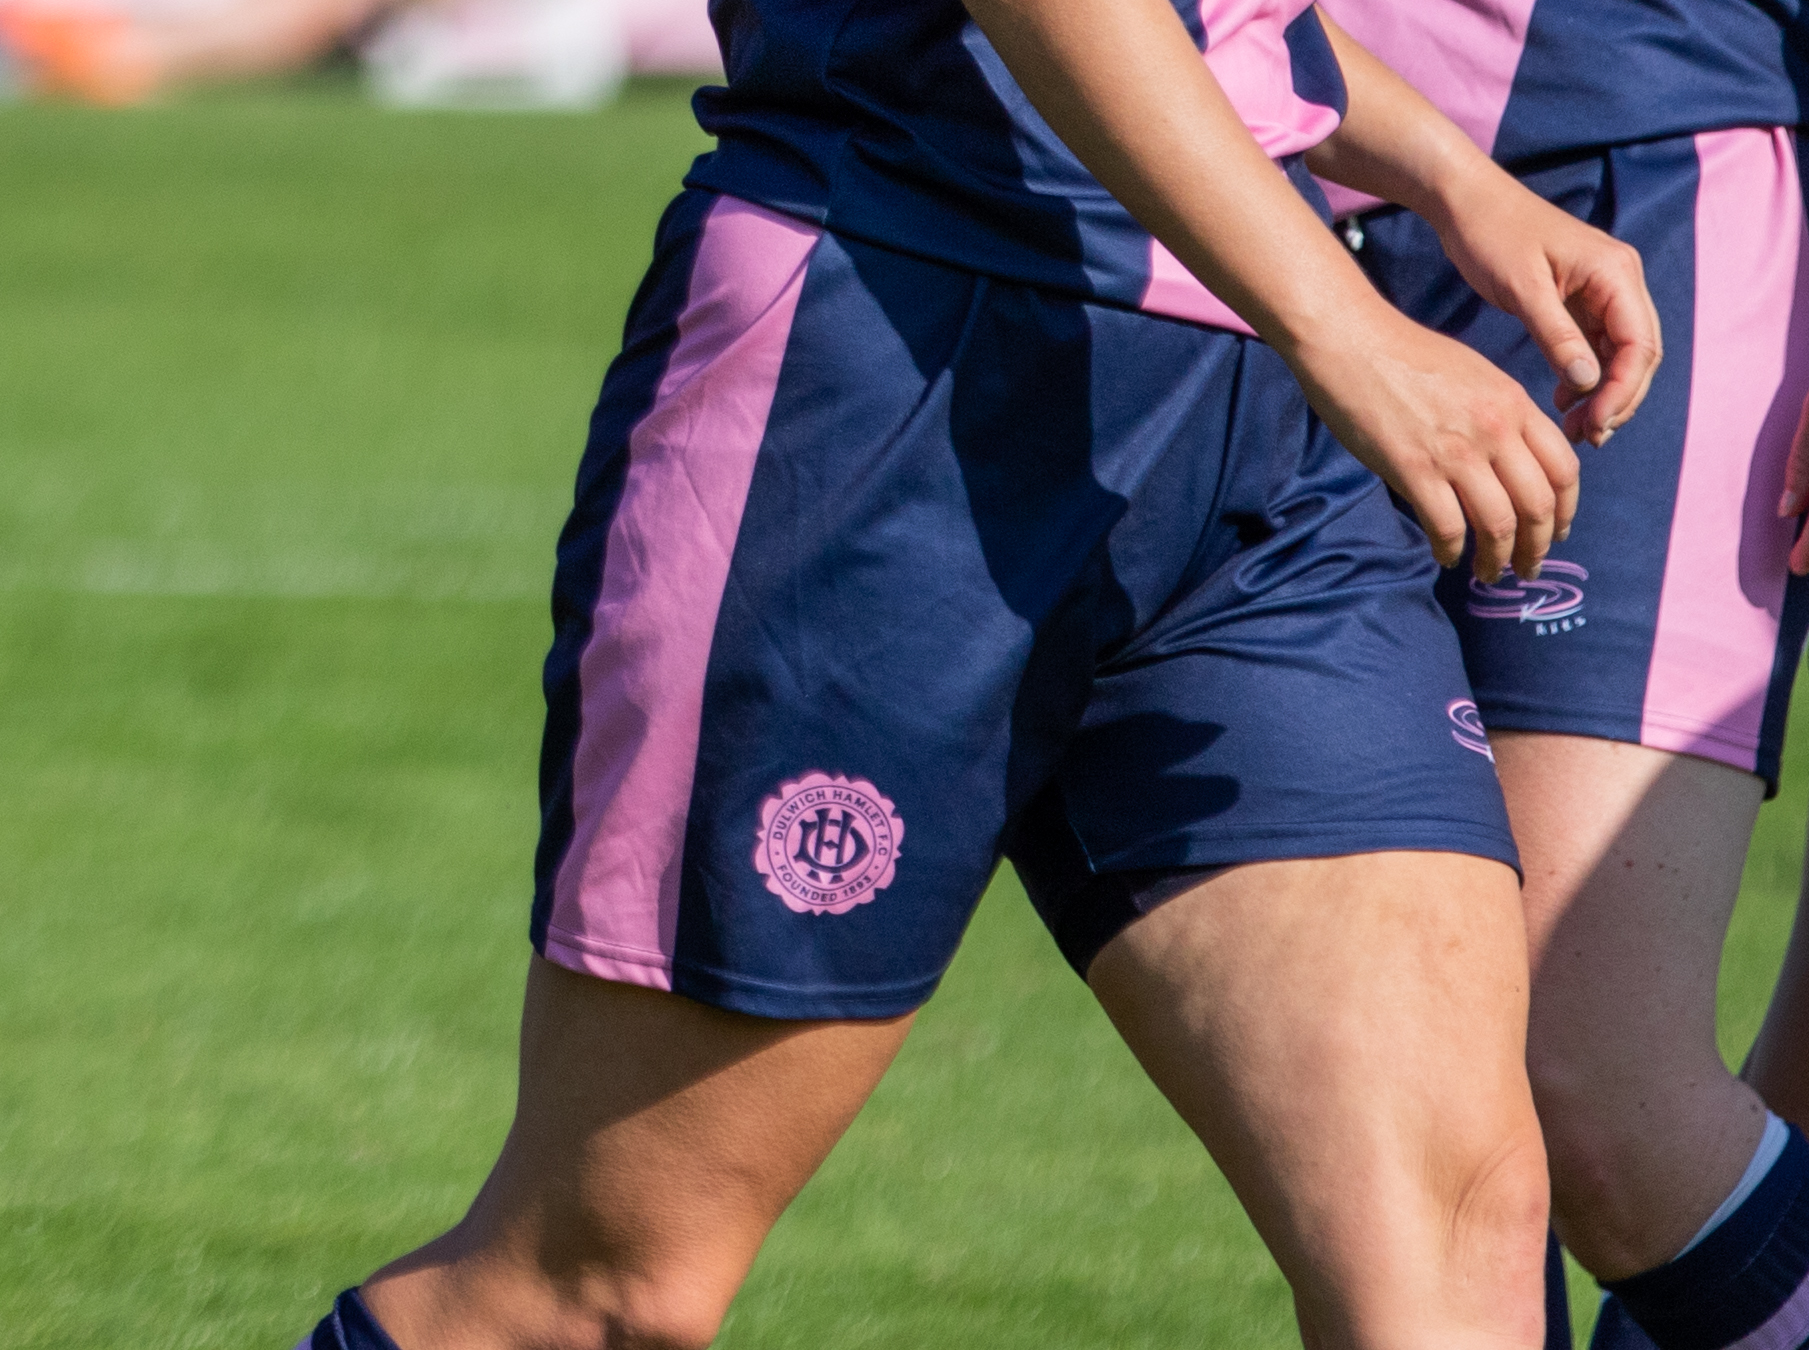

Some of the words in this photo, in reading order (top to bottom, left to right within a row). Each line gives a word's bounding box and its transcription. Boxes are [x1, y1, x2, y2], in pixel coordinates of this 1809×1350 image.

[772, 789, 826, 841] DULWICH
[832, 789, 886, 829] HAMLET
[776, 864, 838, 903] FOUNDED
[842, 875, 873, 898] 1893
